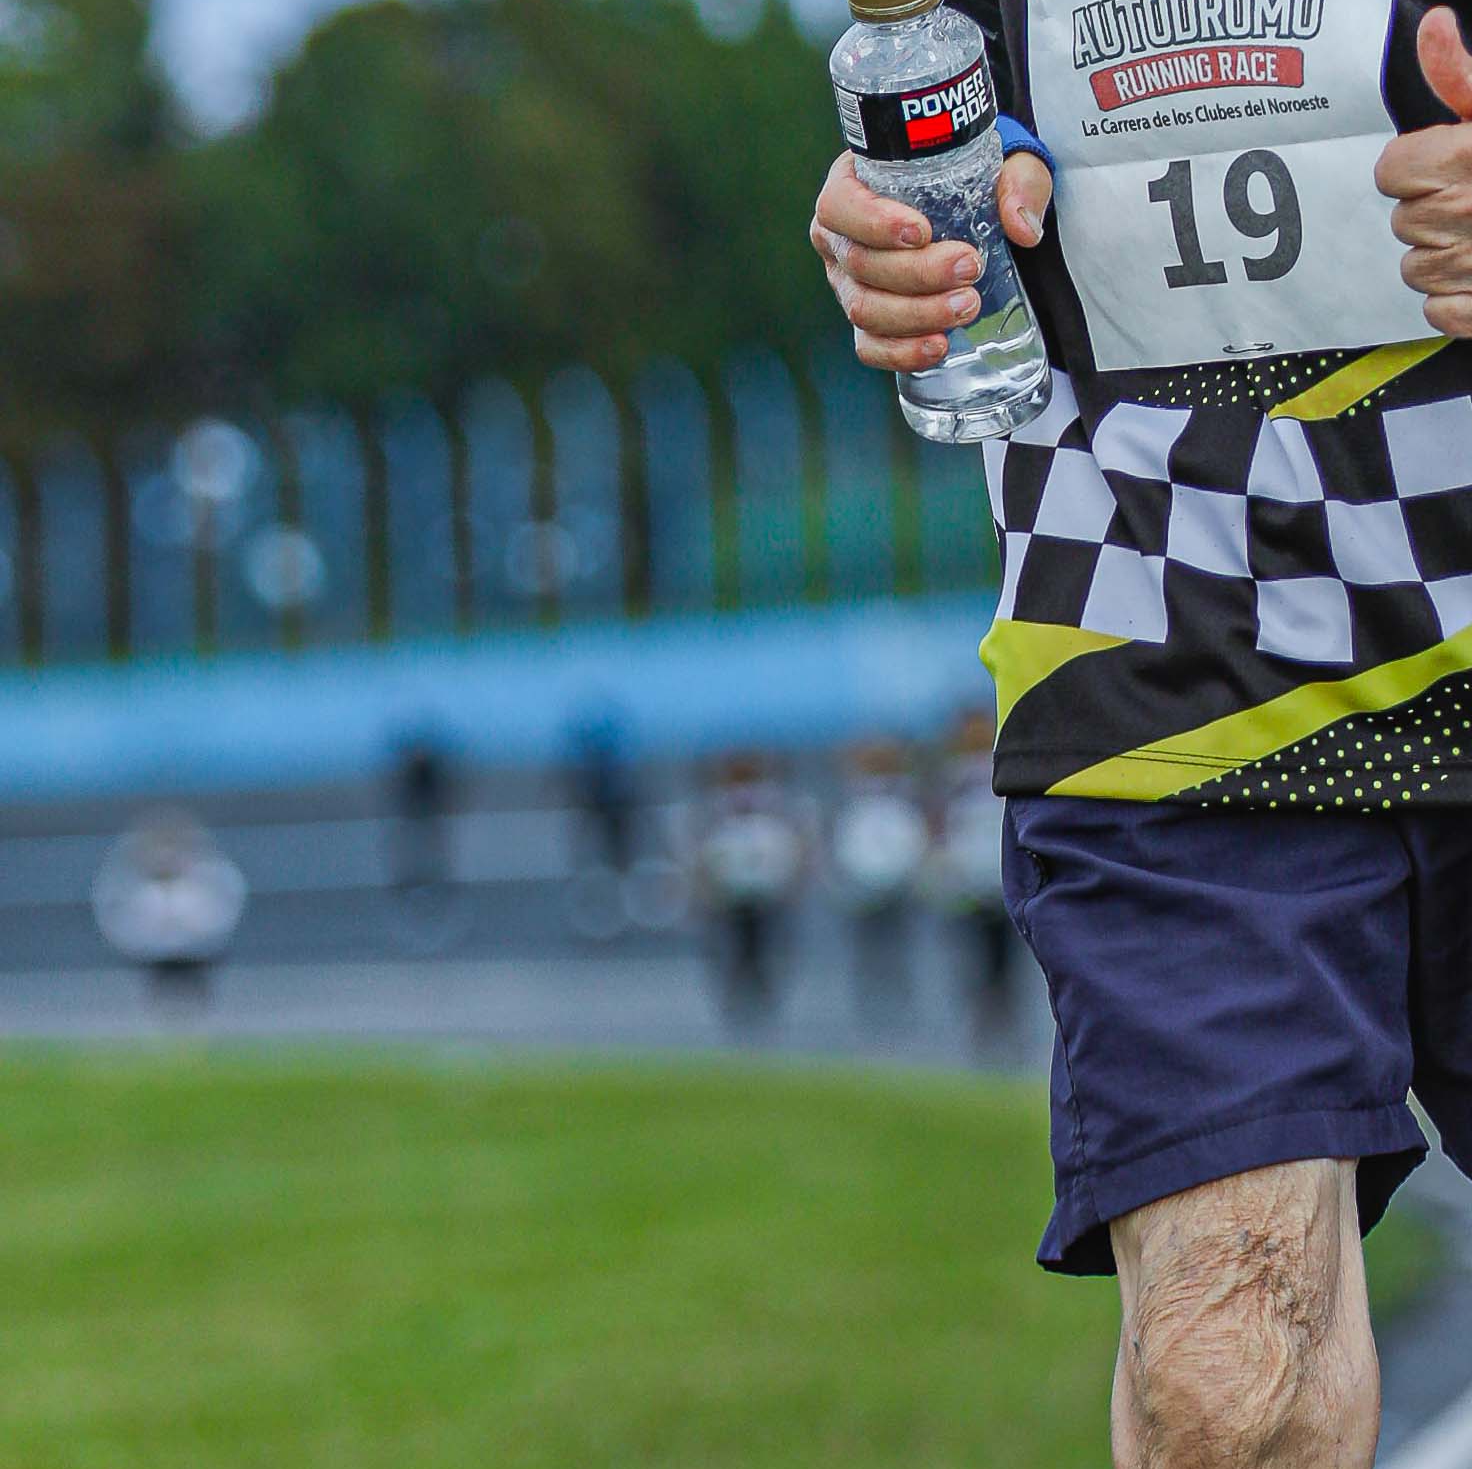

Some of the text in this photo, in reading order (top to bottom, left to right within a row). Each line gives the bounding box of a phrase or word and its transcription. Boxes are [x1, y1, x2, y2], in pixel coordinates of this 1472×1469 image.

[901, 67, 985, 122] POWER
[1112, 51, 1280, 102] RUNNING RACE
[951, 87, 990, 132] ADE
[1081, 94, 1330, 137] La Carrera de los Clubes del Noroeste
[1147, 149, 1303, 289] 19
